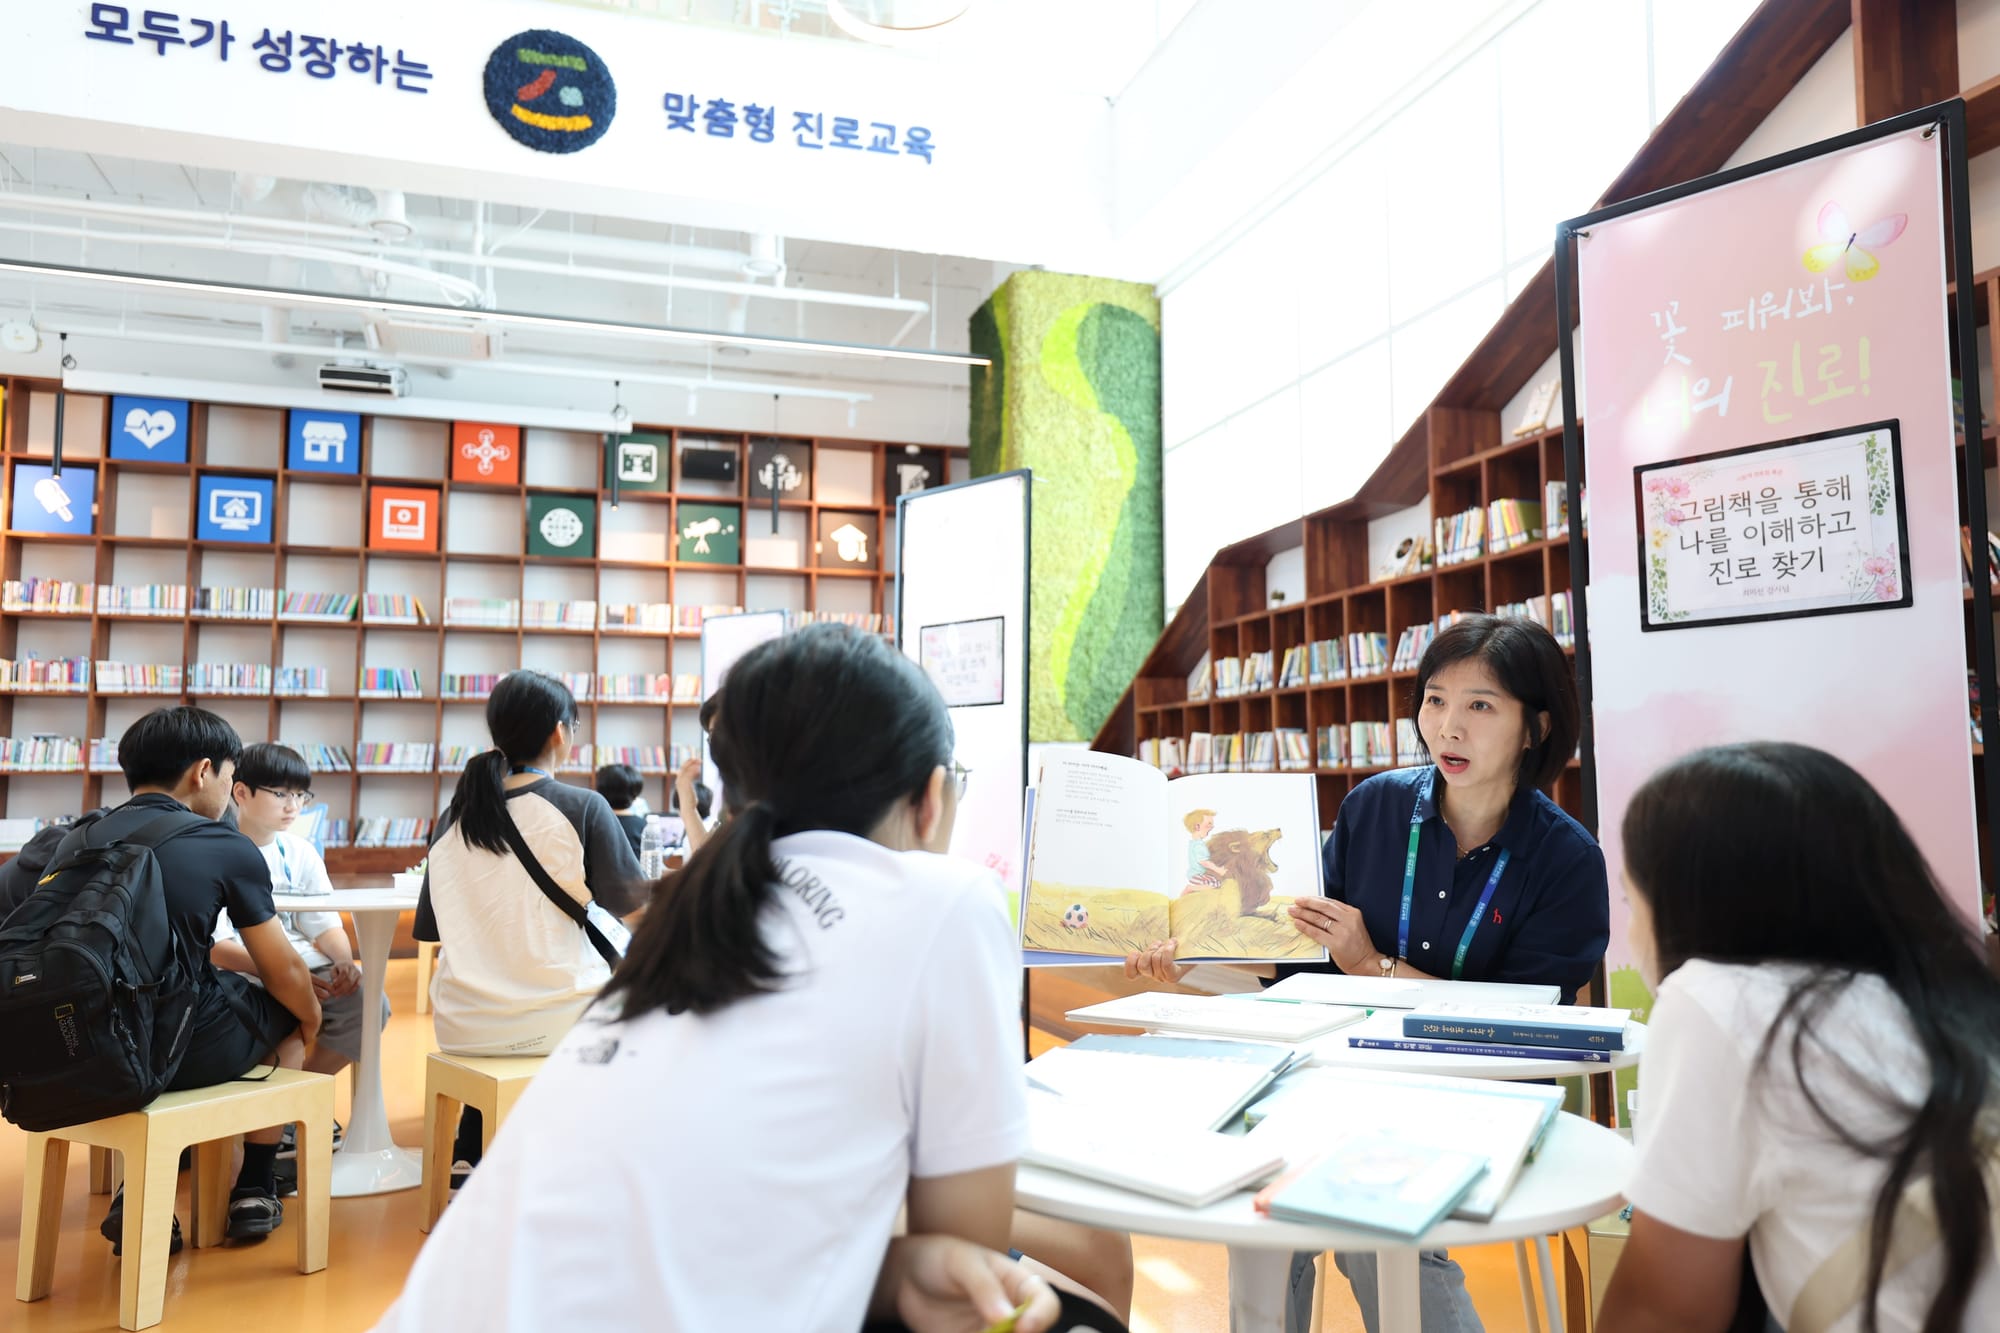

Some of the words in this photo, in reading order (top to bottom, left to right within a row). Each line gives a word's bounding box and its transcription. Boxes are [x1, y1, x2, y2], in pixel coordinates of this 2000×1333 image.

[85, 2, 236, 62] 모두가
[252, 28, 433, 94] 성장하는
[663, 92, 775, 144] 맞춤형
[792, 111, 936, 165] 진로교육
[1650, 300, 1692, 366] 꽃
[1757, 335, 1872, 424] 진로!
[1677, 486, 1783, 523] 그림책을
[1794, 474, 1852, 510] 통해
[1679, 526, 1733, 556] 나를
[1743, 510, 1857, 547] 이해하고
[1708, 556, 1761, 587] 진로
[1771, 546, 1825, 580] 찾기
